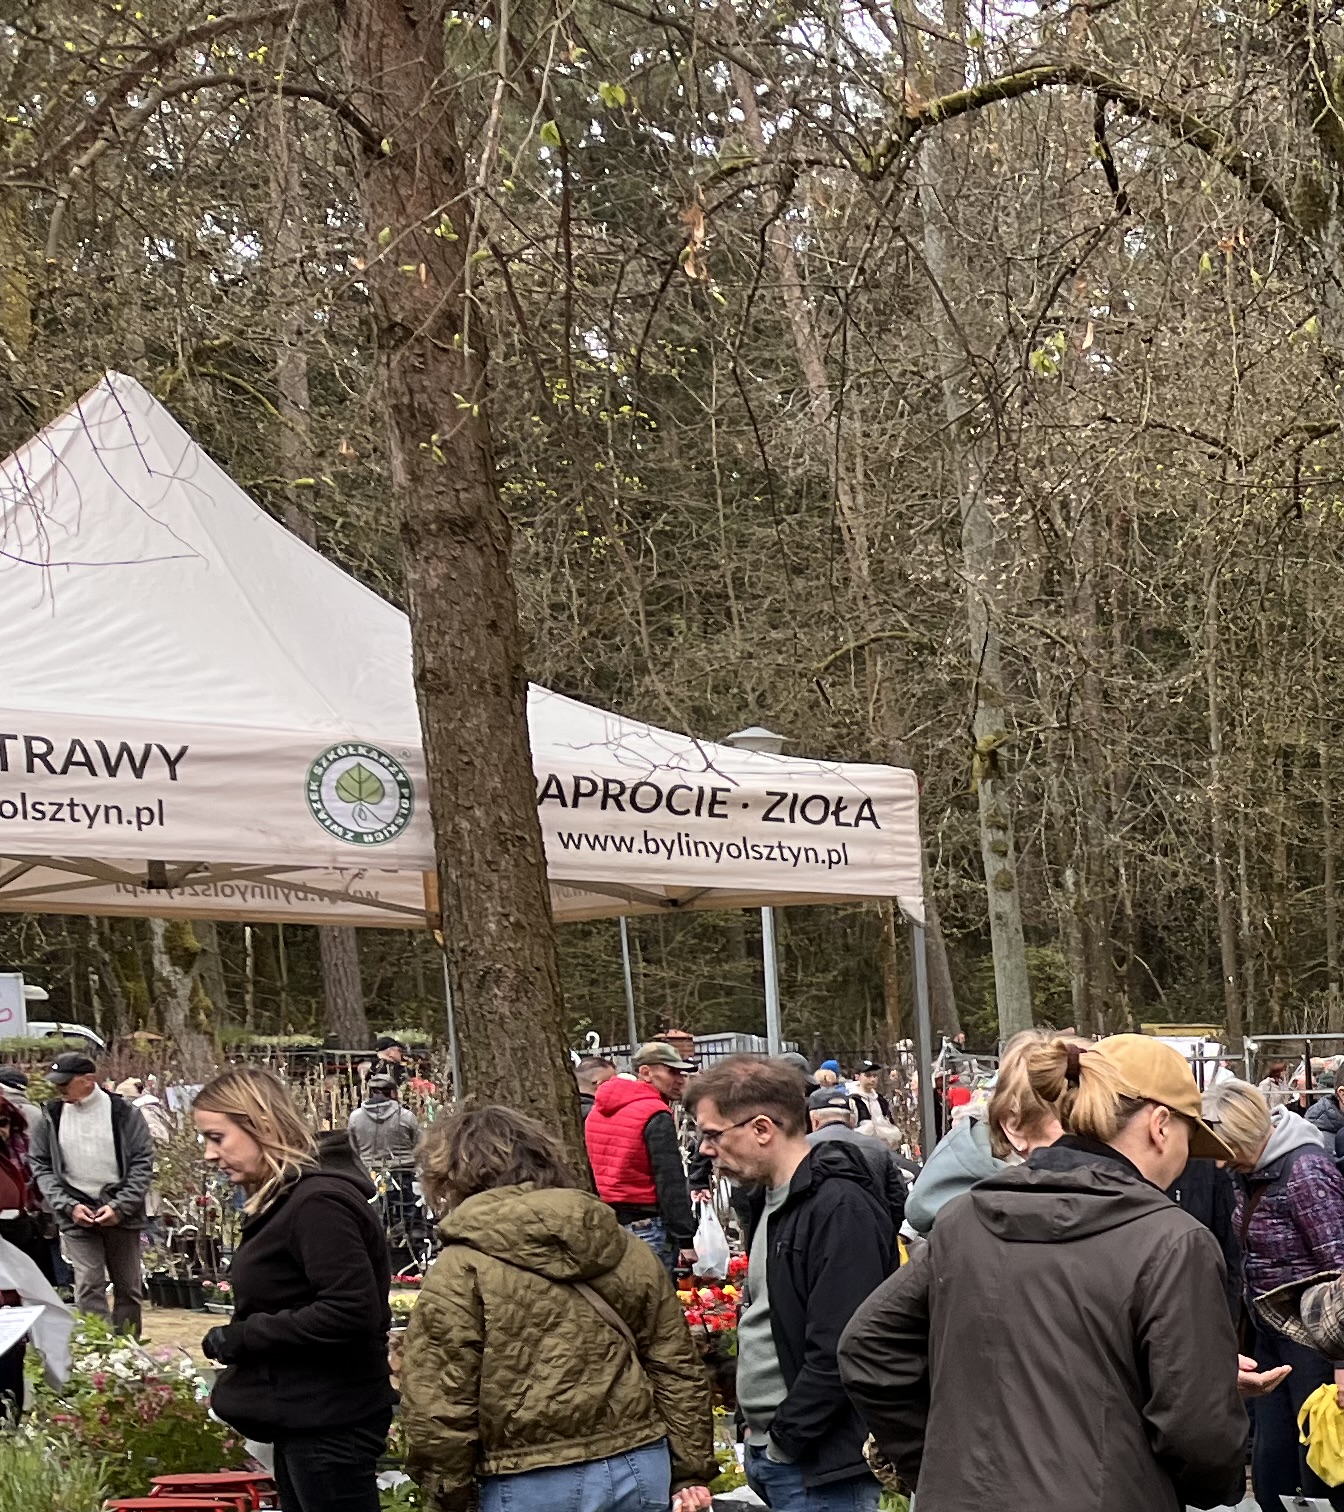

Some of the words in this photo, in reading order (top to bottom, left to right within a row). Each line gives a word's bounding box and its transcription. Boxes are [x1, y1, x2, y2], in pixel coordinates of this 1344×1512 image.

[0, 733, 189, 781] TRAWY
[538, 773, 731, 819] APROCIE
[762, 789, 881, 829] ZIOŁA
[557, 829, 849, 870] www.bylinyolsztyn.pl
